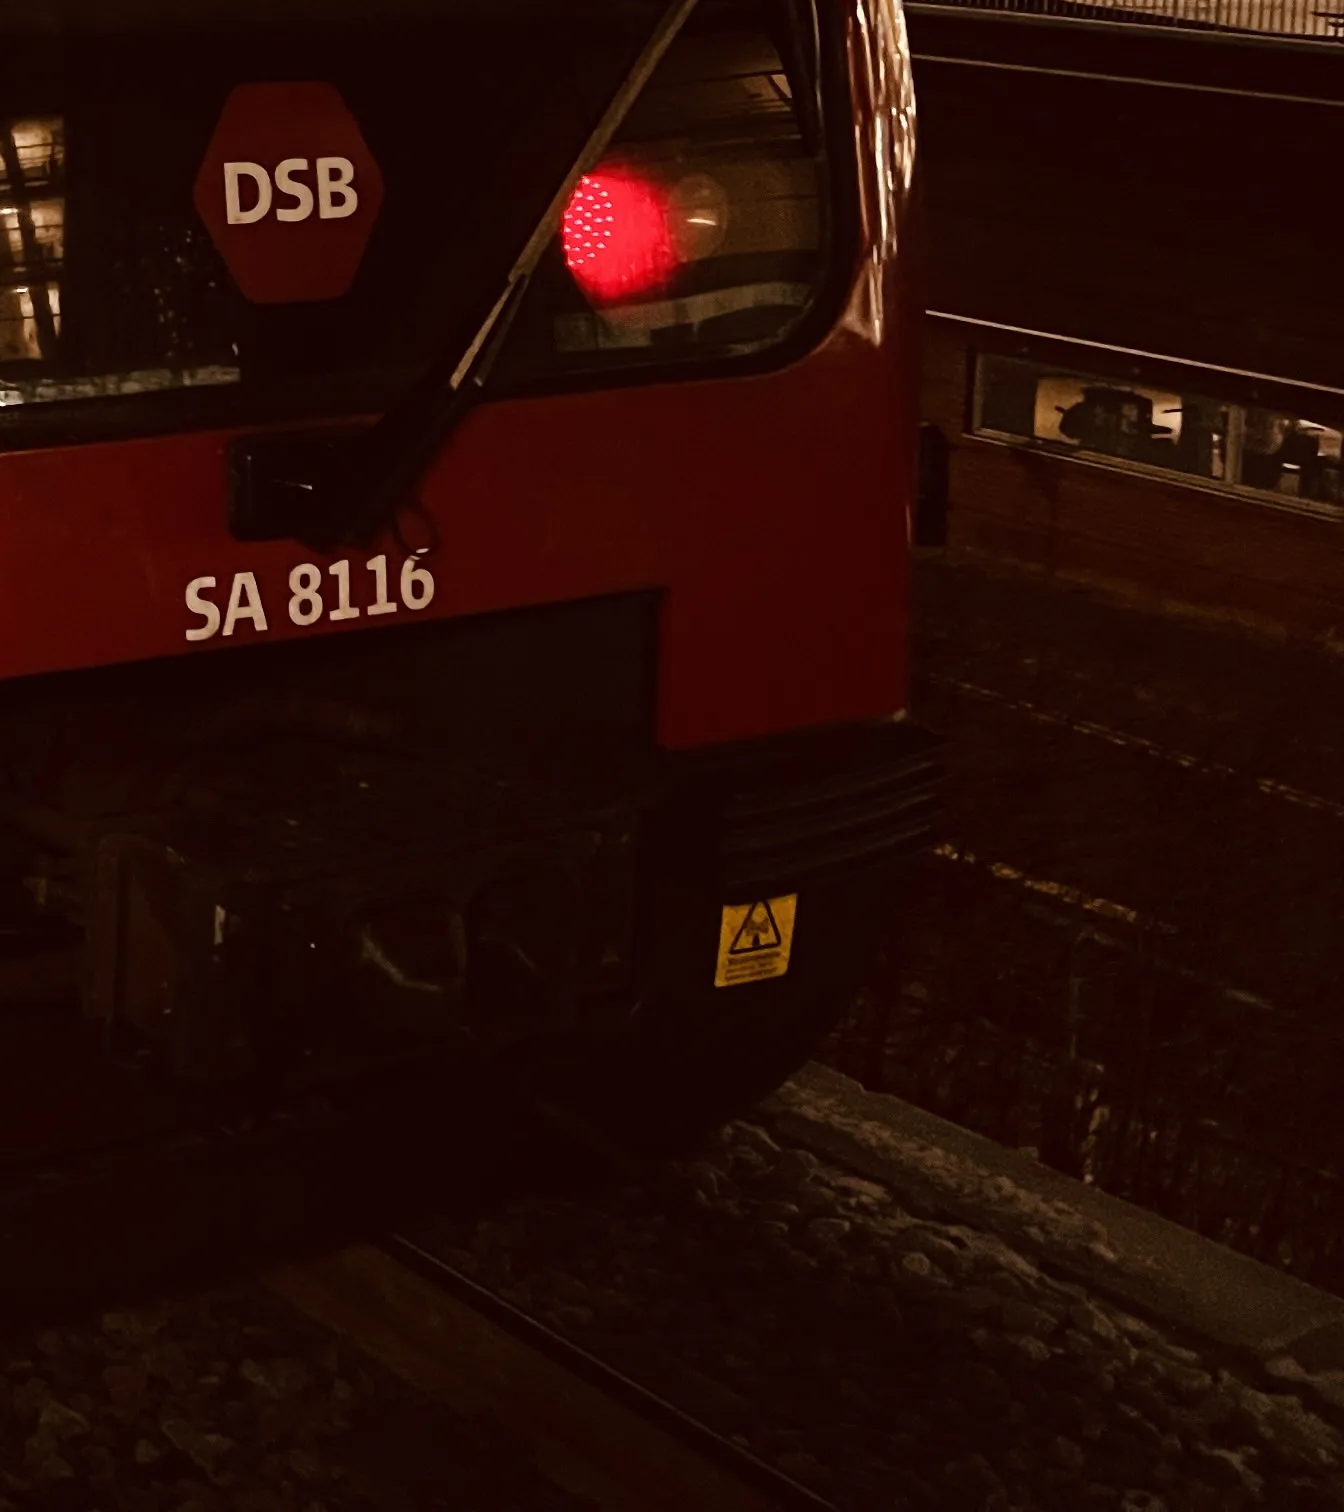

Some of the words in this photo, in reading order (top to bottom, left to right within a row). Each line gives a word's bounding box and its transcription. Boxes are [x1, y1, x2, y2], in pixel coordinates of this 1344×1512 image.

[223, 156, 359, 225] DSB
[185, 571, 268, 642] SA
[288, 554, 435, 626] 8116
